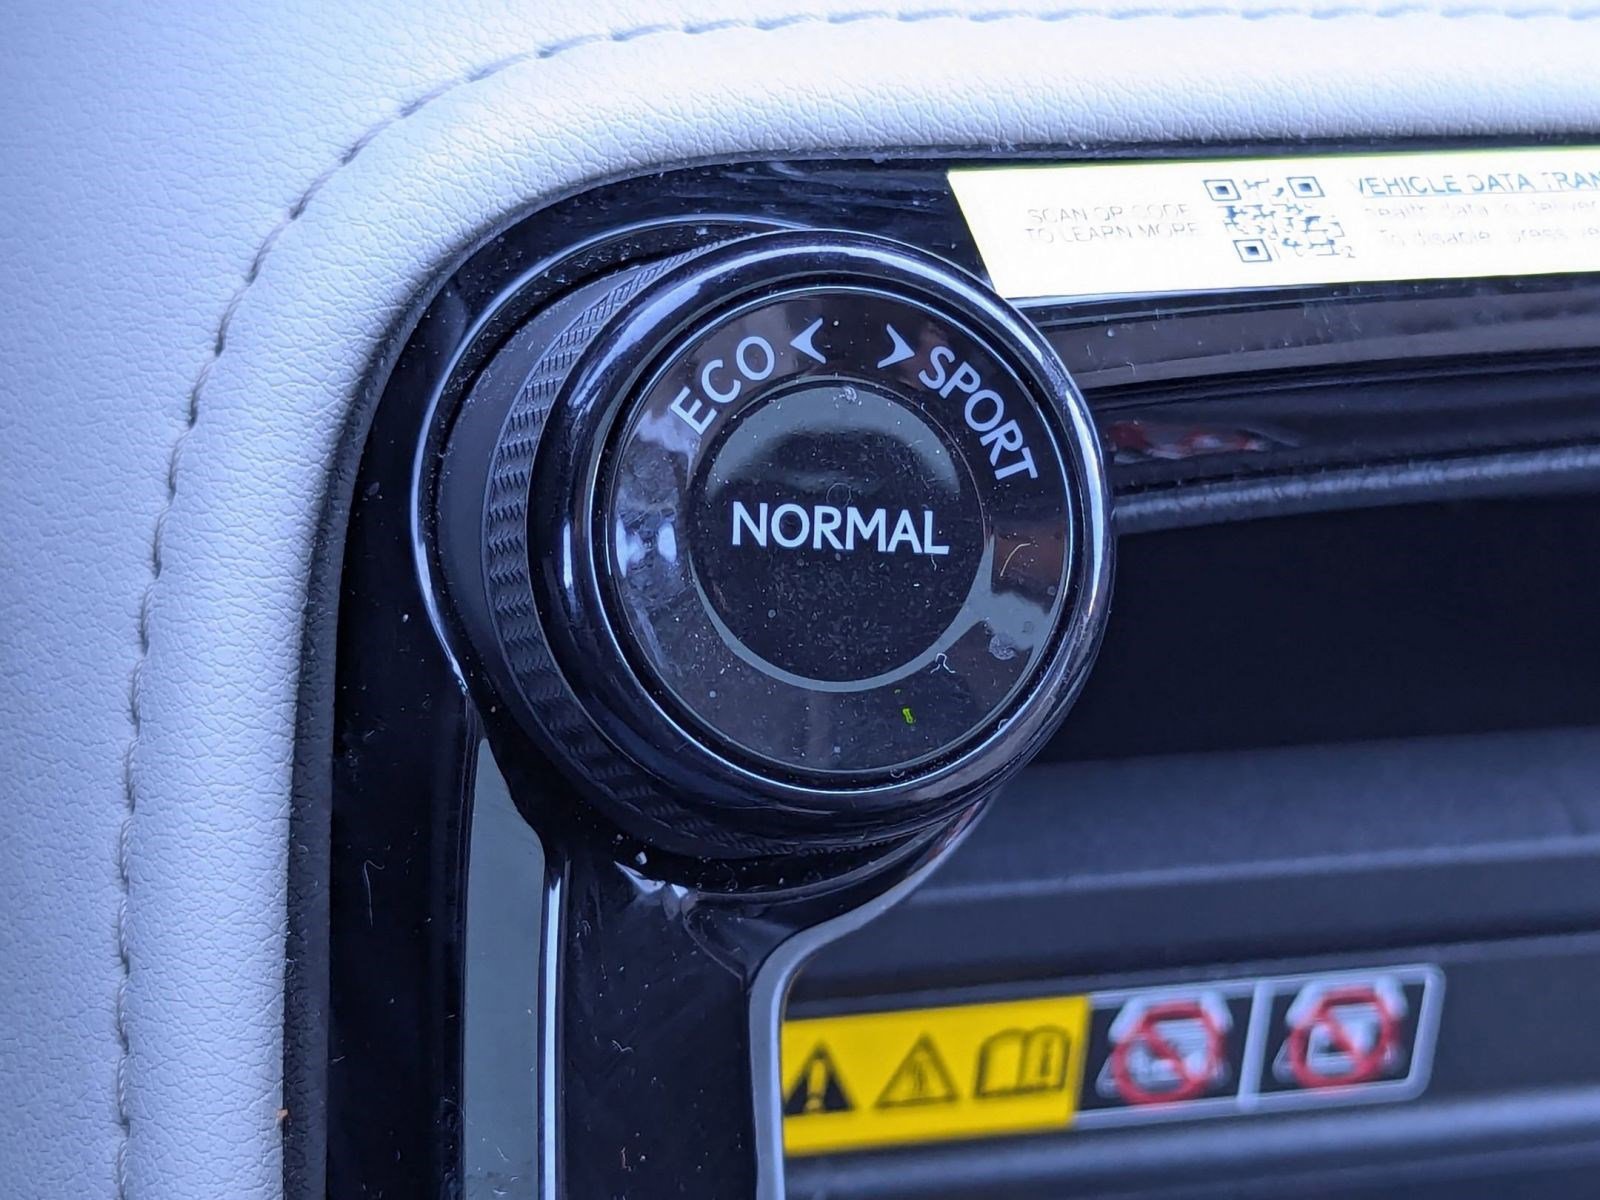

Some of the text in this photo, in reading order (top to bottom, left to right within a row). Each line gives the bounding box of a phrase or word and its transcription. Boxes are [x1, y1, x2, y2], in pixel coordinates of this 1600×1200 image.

[1353, 175, 1464, 196] VEHICLE
[1467, 173, 1535, 193] DATA
[1027, 207, 1088, 224] SCAN
[670, 336, 776, 435] ECO
[918, 345, 1039, 481] SPORT
[731, 500, 950, 556] NORMAL
